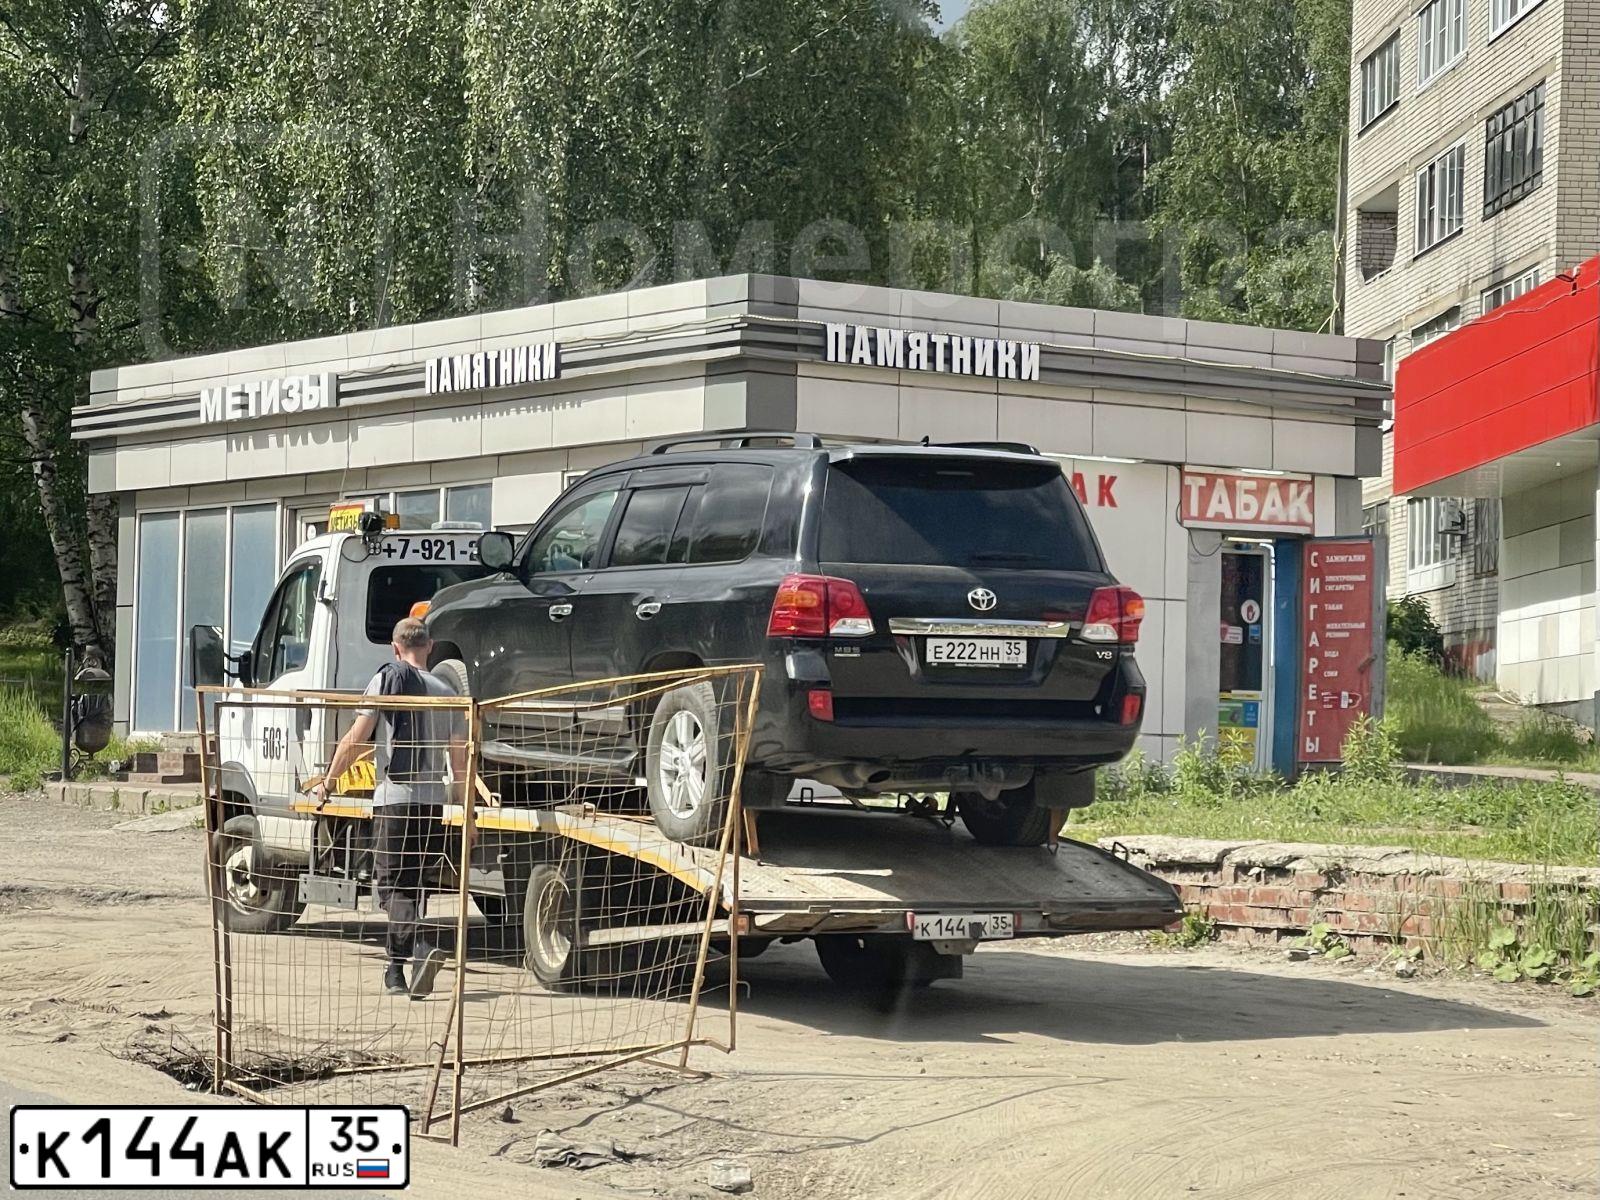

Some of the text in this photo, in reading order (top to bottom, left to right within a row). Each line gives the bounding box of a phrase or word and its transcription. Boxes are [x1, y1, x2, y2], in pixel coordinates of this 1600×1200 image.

[424, 342, 560, 394] ПАМЯТНИКИ
[826, 322, 1040, 381] ПАМЯТНИКИ
[200, 372, 337, 424] МЕТИЗЫ
[1071, 472, 1118, 508] АК
[1184, 475, 1314, 524] ТАБАК
[933, 641, 1021, 661] Е222НН 35
[1096, 651, 1113, 659] V8
[1304, 551, 1320, 754] СИГАРЕТЫ
[262, 726, 289, 761] 503-1
[921, 916, 1008, 937] К144К 35
